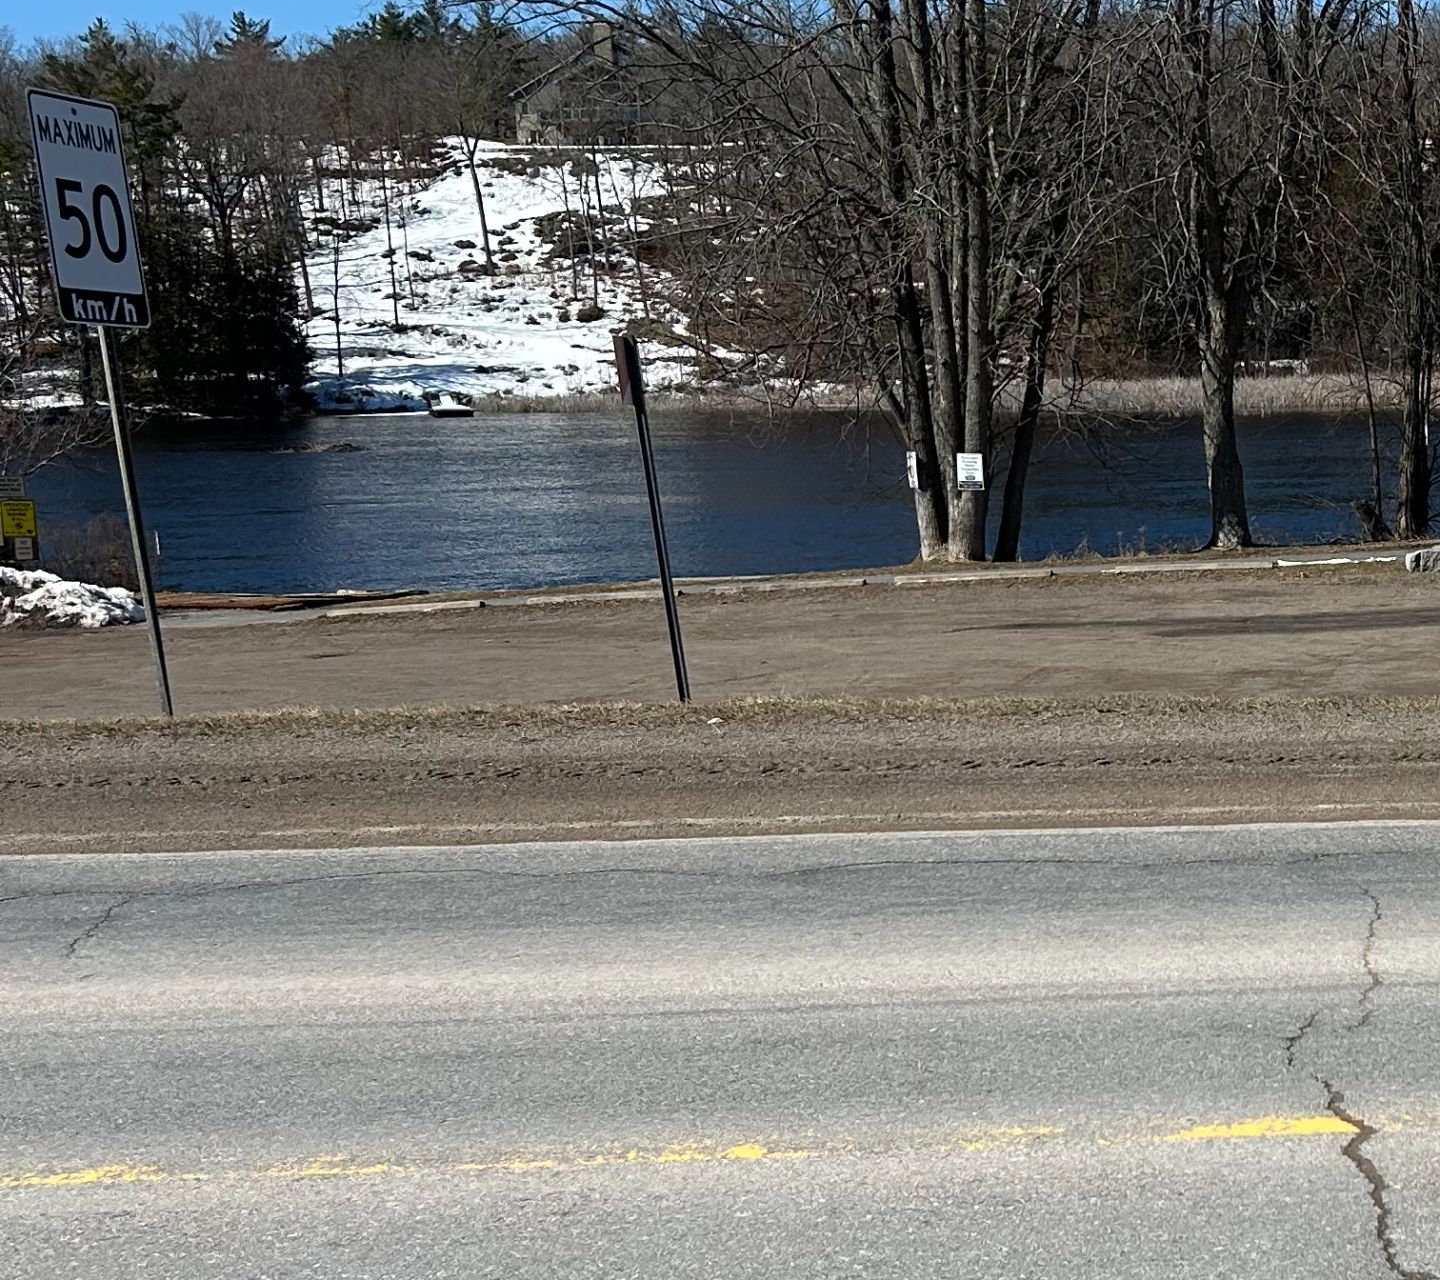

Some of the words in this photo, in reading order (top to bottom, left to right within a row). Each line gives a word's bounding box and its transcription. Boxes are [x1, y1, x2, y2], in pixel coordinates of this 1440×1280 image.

[37, 114, 116, 154] MAXIMUM
[55, 177, 127, 263] 50
[71, 292, 137, 323] km/h
